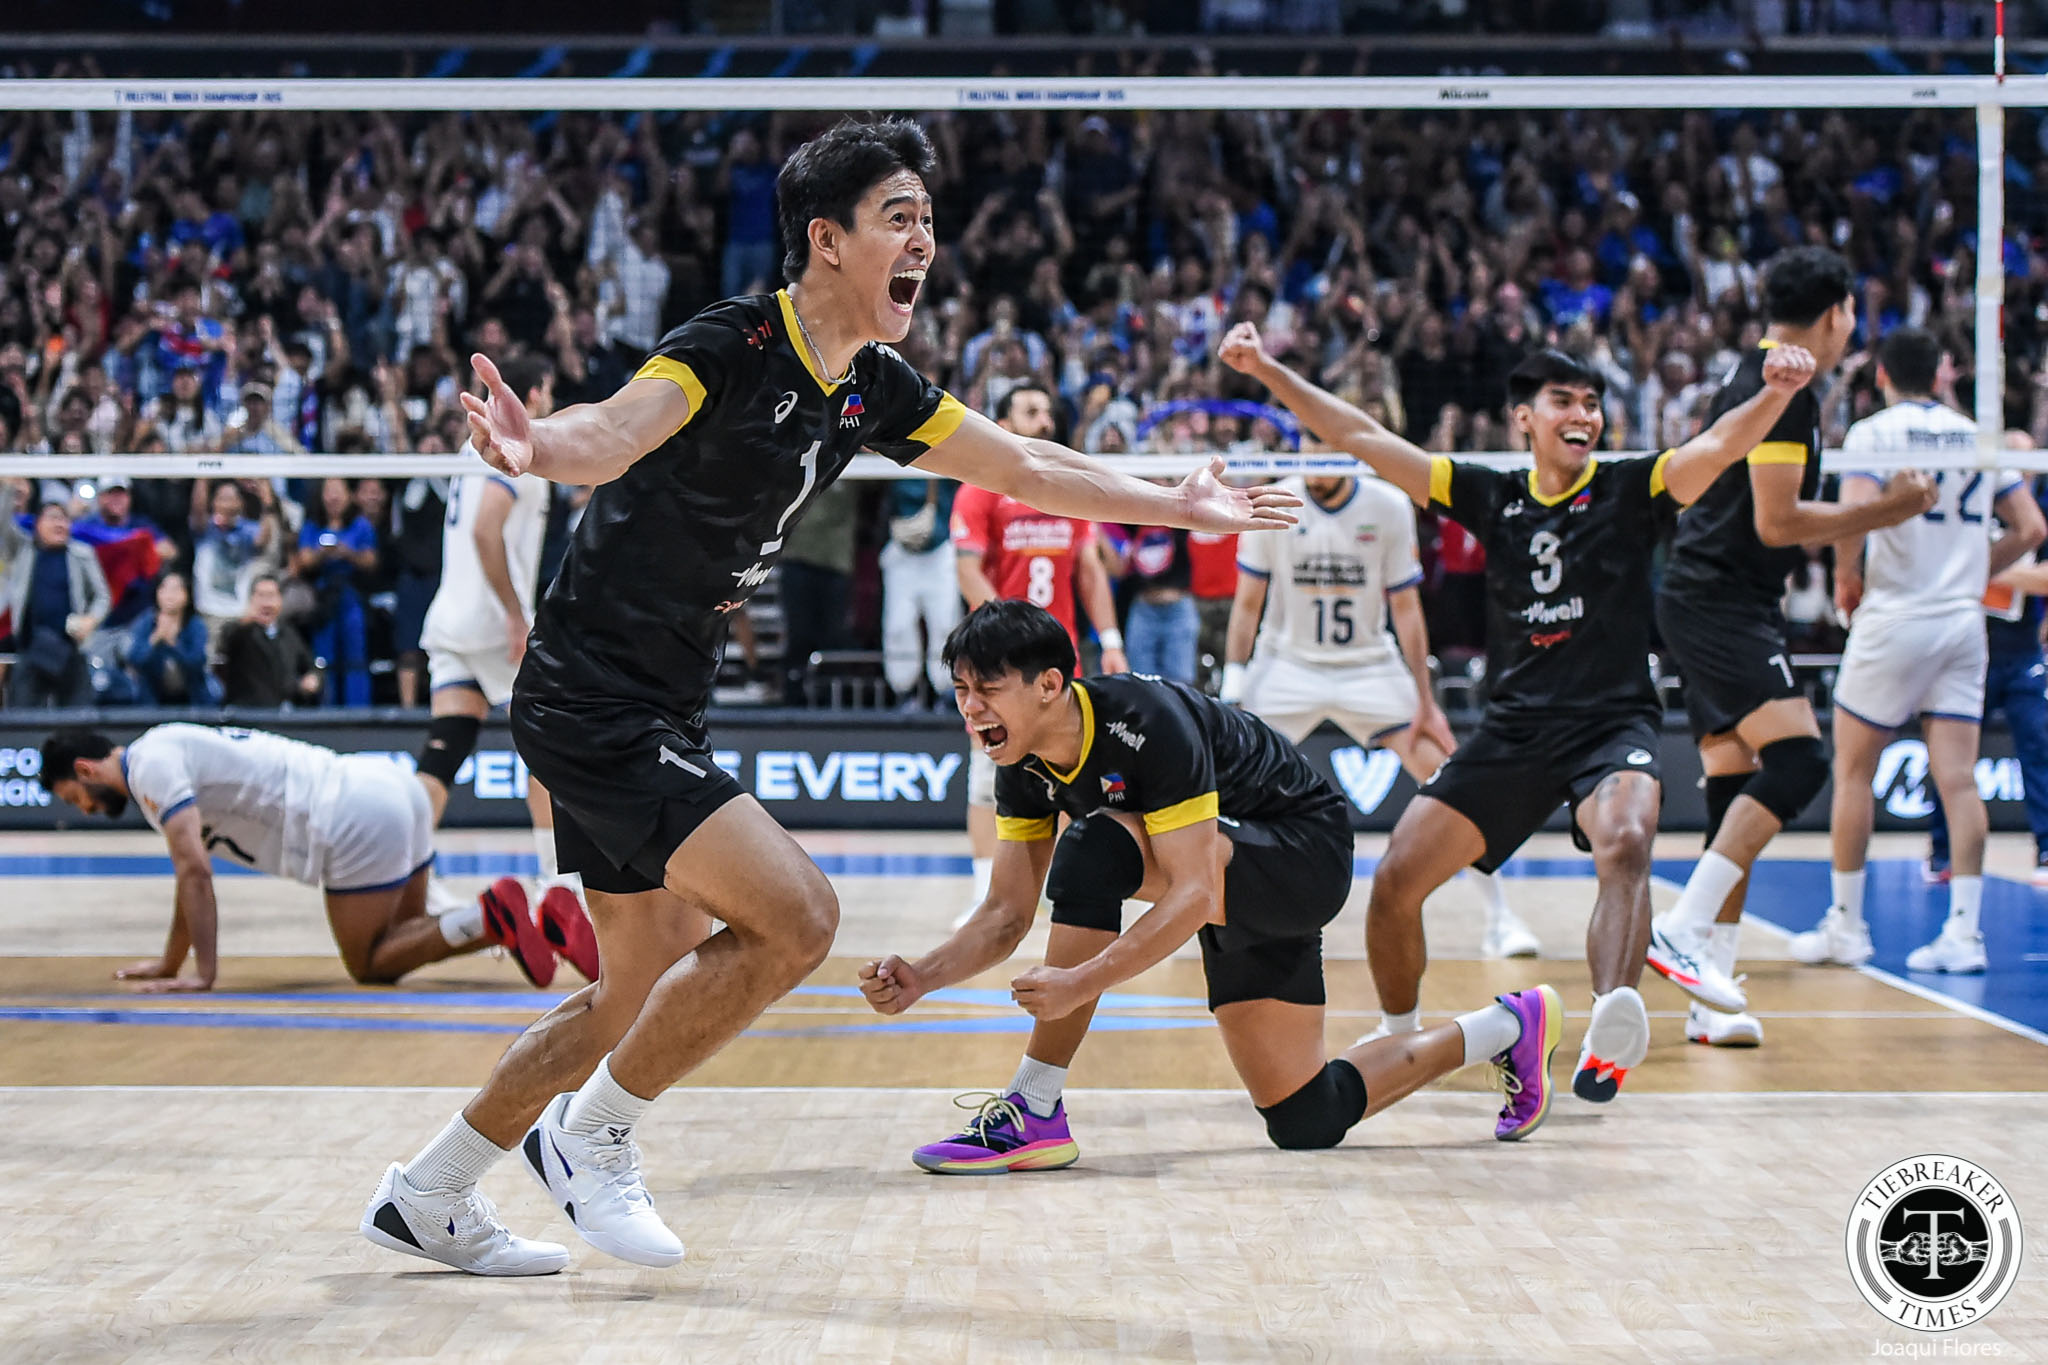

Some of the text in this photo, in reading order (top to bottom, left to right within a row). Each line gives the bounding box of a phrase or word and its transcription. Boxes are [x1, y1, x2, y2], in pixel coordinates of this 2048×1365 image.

[838, 415, 861, 430] PHI
[759, 440, 822, 556] 1
[1027, 556, 1054, 609] 8
[1528, 530, 1563, 594] 3
[1312, 598, 1354, 645] 15
[658, 744, 708, 779] 1
[755, 751, 963, 802] EVERY
[1107, 791, 1126, 804] PHI
